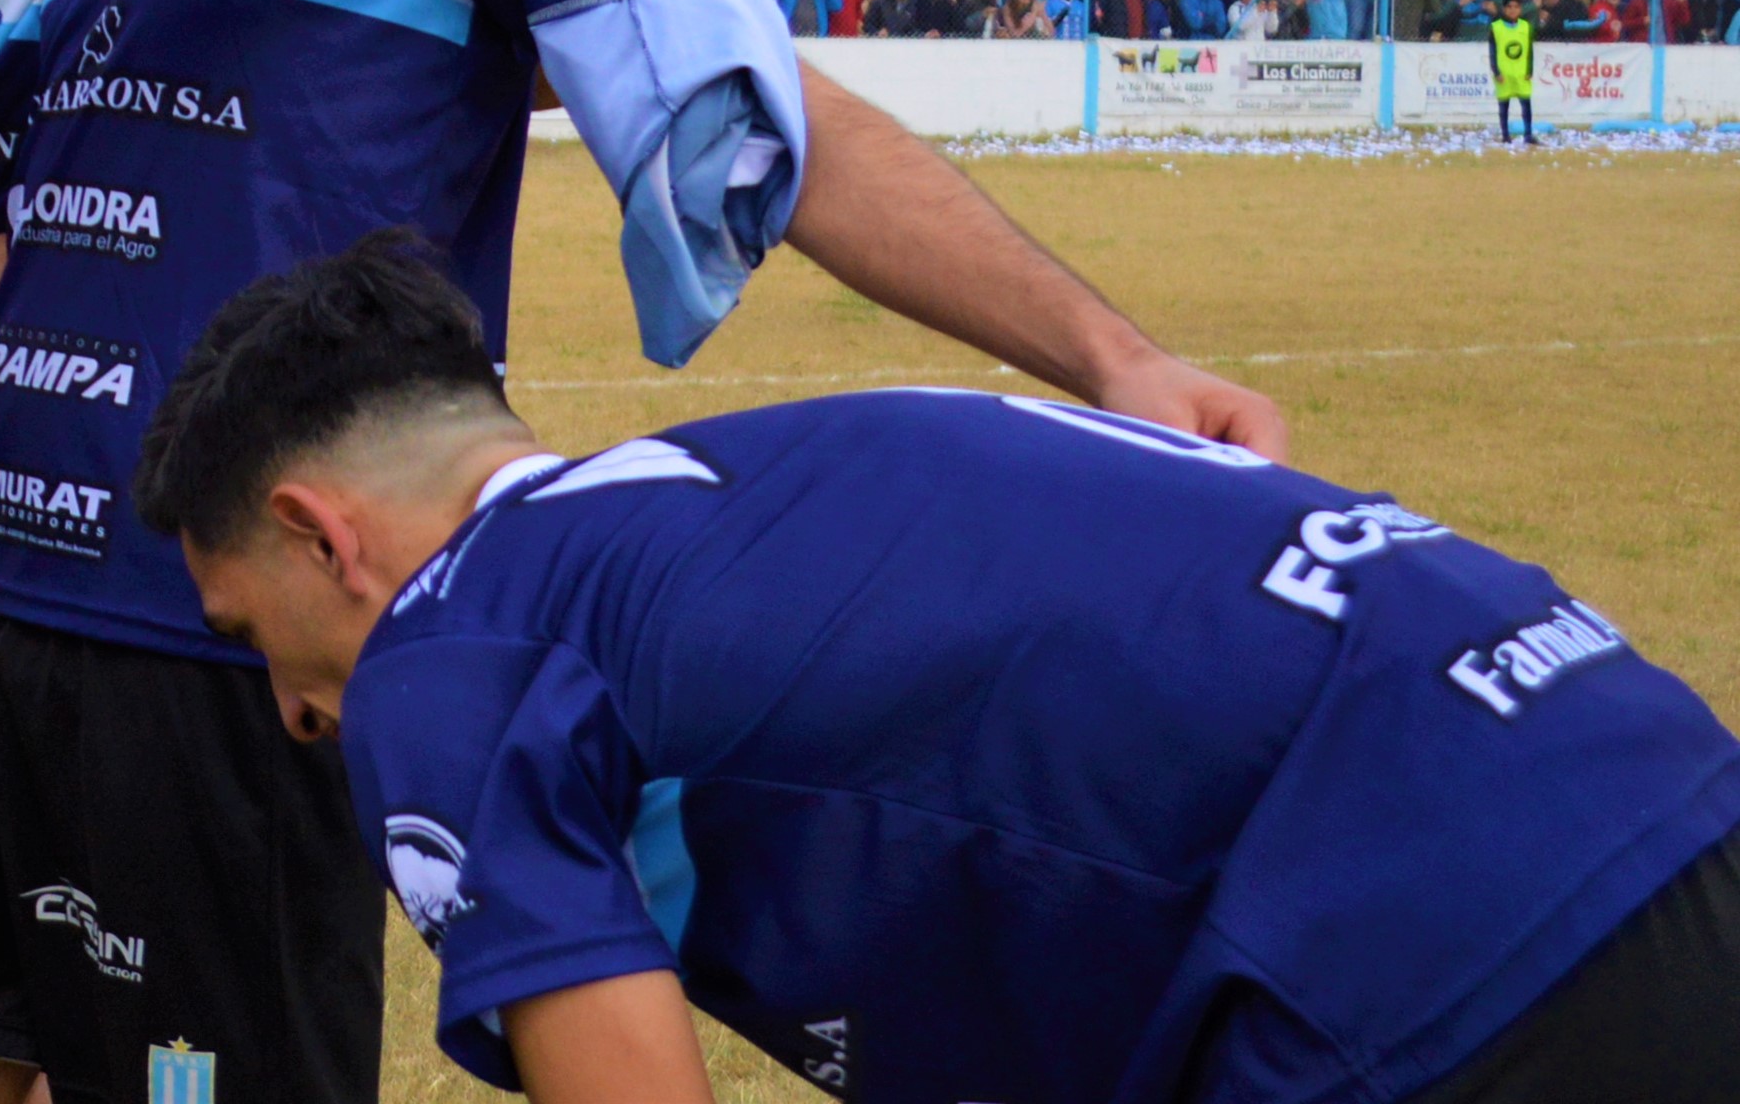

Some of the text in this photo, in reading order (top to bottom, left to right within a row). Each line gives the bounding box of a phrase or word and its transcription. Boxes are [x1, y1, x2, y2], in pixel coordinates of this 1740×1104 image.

[1254, 45, 1363, 59] VETERINARIA
[1263, 63, 1357, 79] Los Chañares
[1552, 56, 1624, 78] cerdos
[1439, 73, 1488, 85] CARNES
[1577, 77, 1593, 99] &
[1426, 87, 1438, 97] EL
[1442, 86, 1482, 97] PICHON
[172, 86, 248, 131] S.A
[7, 182, 161, 239] LONDRA
[63, 231, 92, 248] para
[96, 233, 110, 250] el
[114, 235, 157, 260] Agro
[803, 1015, 848, 1088] S.A
